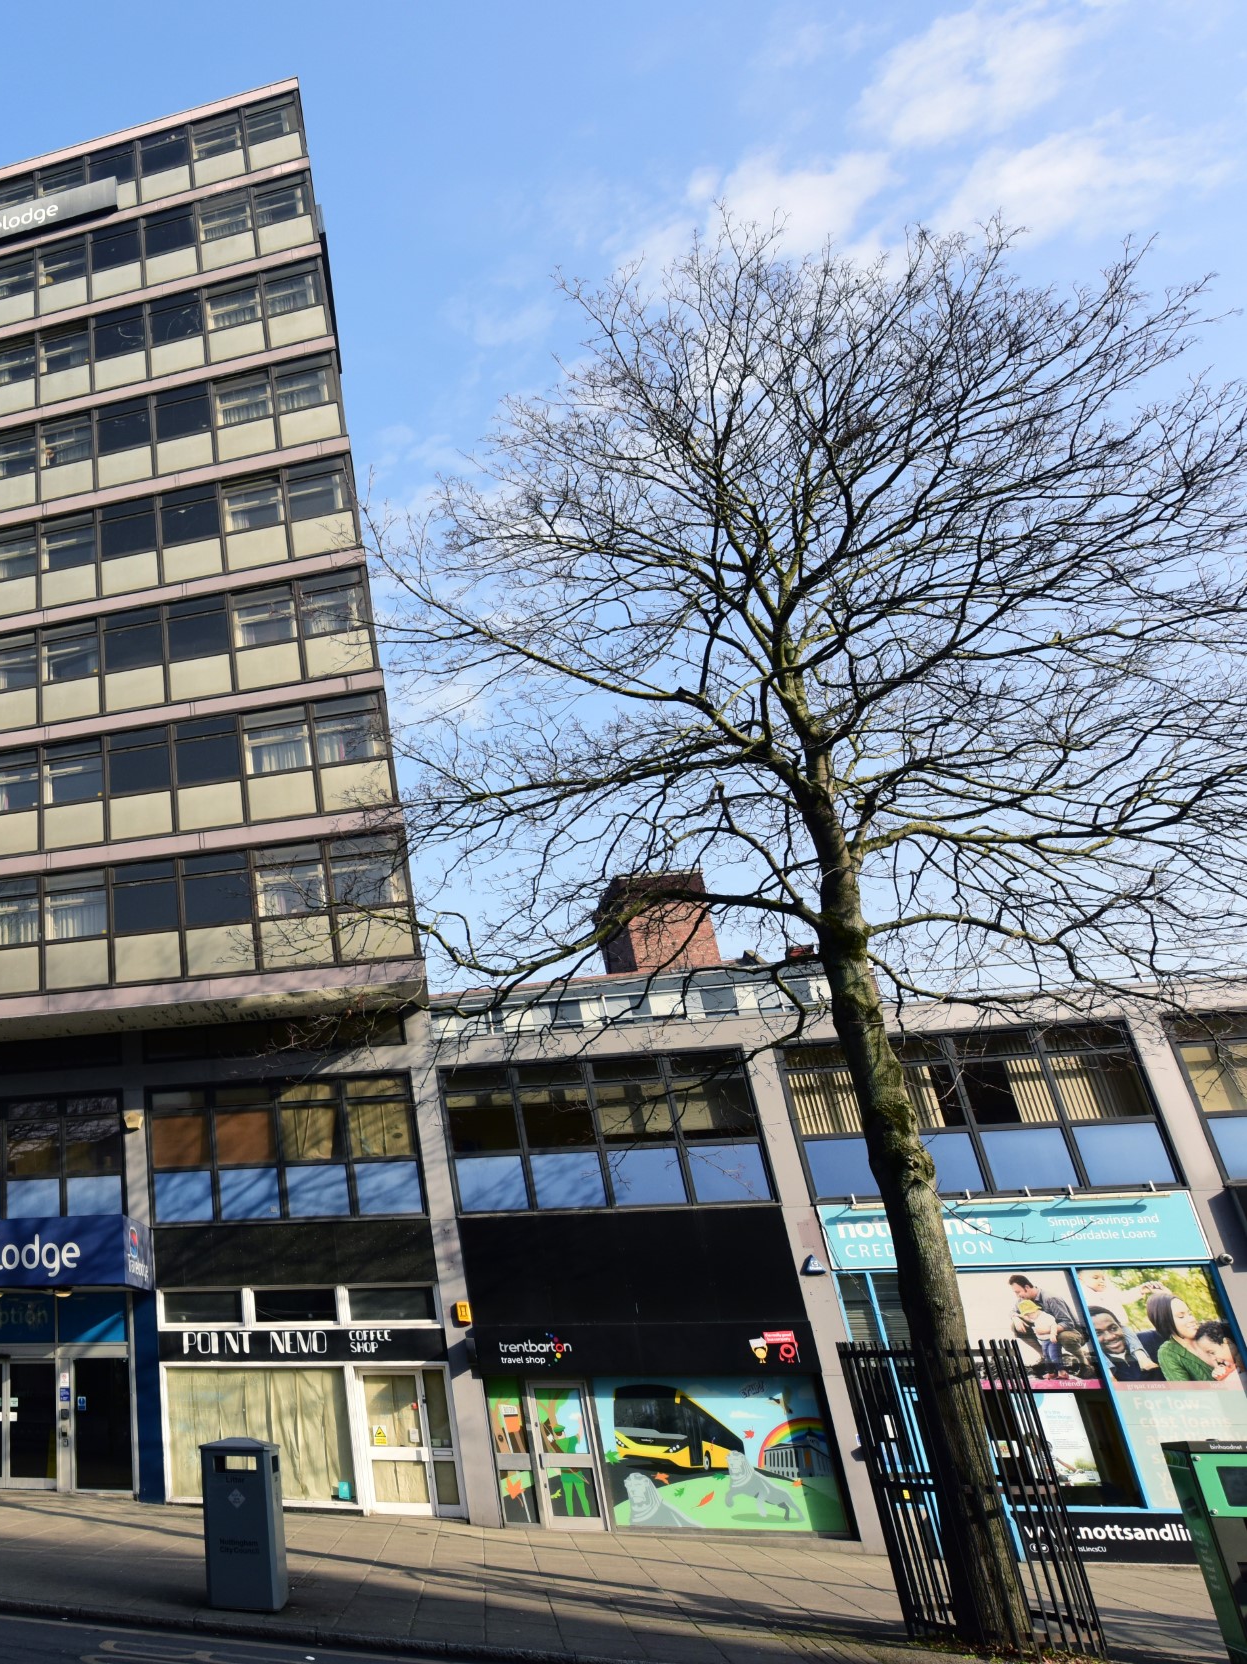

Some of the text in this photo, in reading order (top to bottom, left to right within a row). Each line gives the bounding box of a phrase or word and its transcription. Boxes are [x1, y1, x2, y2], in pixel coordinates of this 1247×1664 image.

[1047, 1213, 1160, 1228] Simple Savings and
[1060, 1229, 1157, 1241] affordable Loans
[845, 1243, 895, 1258] CRED
[348, 1329, 392, 1341] COFFEE
[182, 1330, 327, 1354] POINT NEMO
[350, 1341, 379, 1353] SHOP
[498, 1339, 573, 1353] trentbarton
[500, 1355, 546, 1365] travel shop
[1058, 1380, 1087, 1389] friendly
[1133, 1395, 1200, 1410] For low
[1140, 1414, 1232, 1428] cost loans
[225, 1475, 245, 1484] Litter
[219, 1537, 259, 1547] Nottingham
